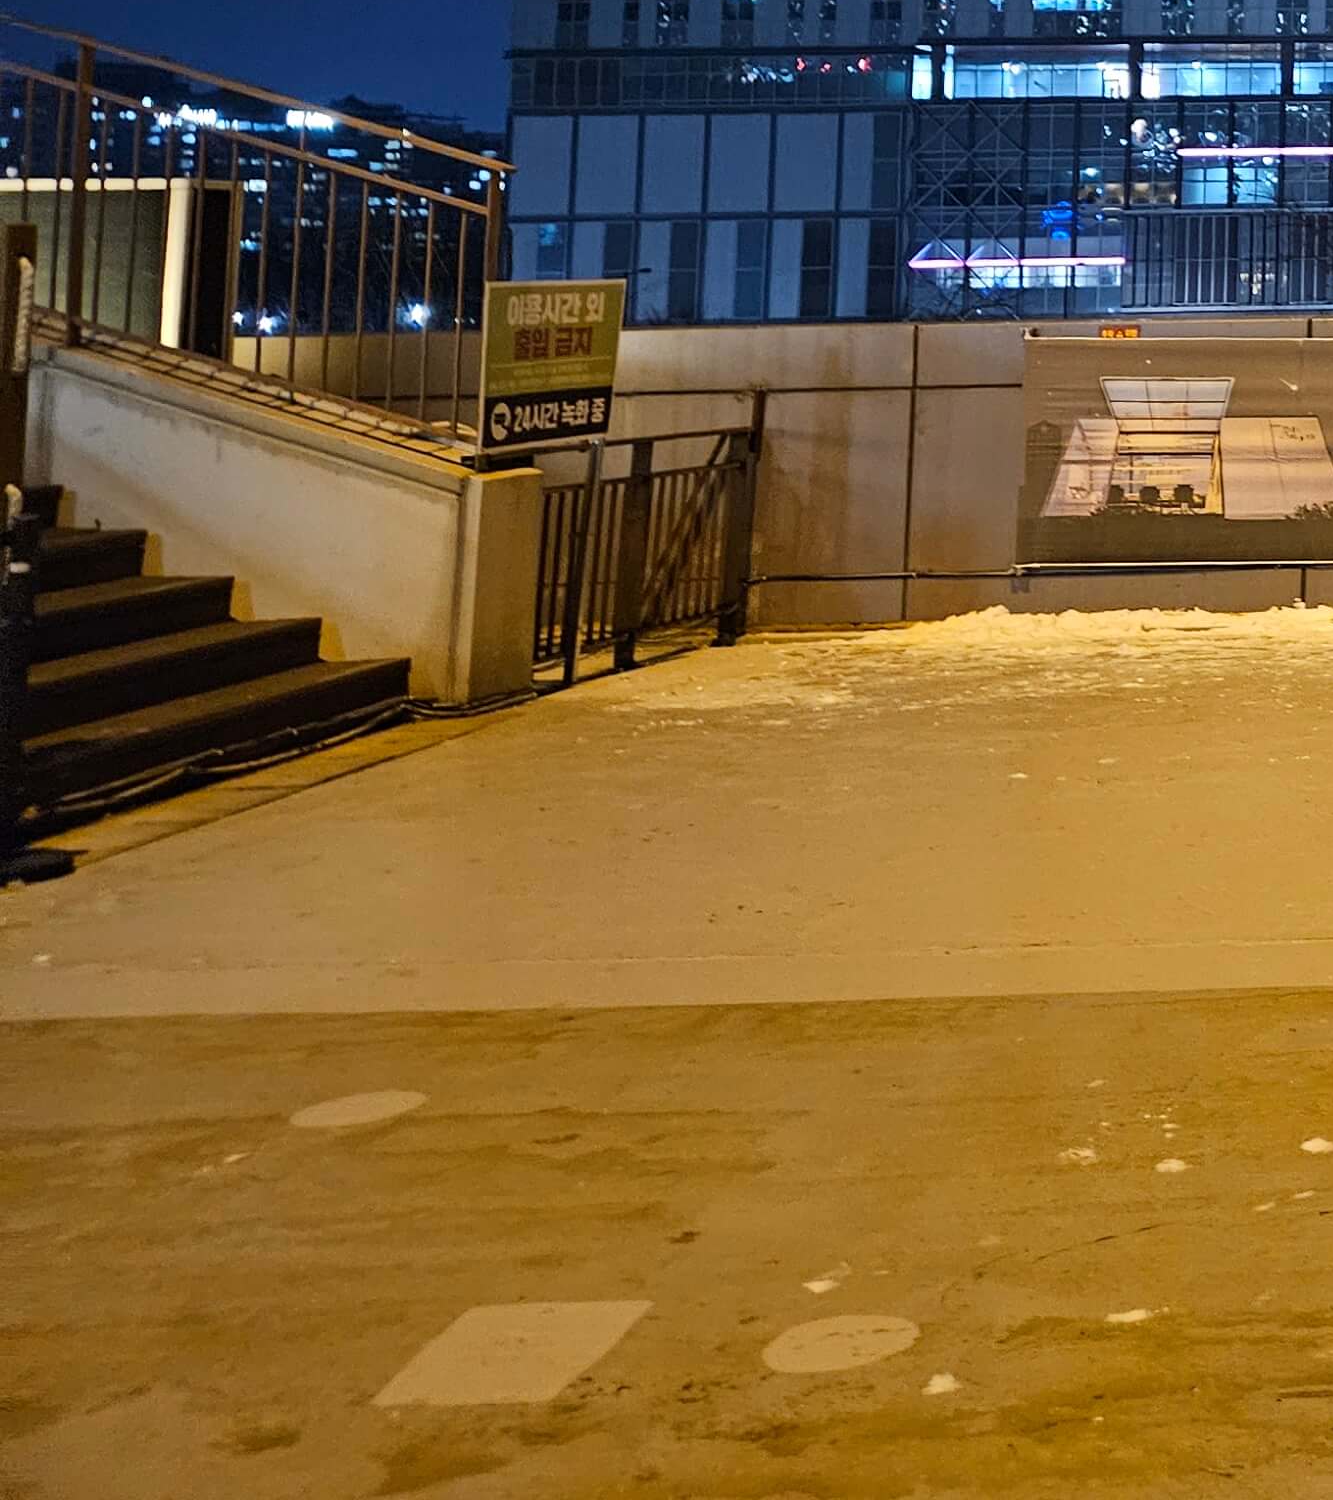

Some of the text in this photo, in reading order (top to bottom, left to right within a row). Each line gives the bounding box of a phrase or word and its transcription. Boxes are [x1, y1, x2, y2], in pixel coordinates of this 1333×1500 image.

[507, 291, 606, 326] 이용시간 외
[513, 326, 594, 361] 출입 금지
[513, 396, 607, 433] 24시간 녹화 중
